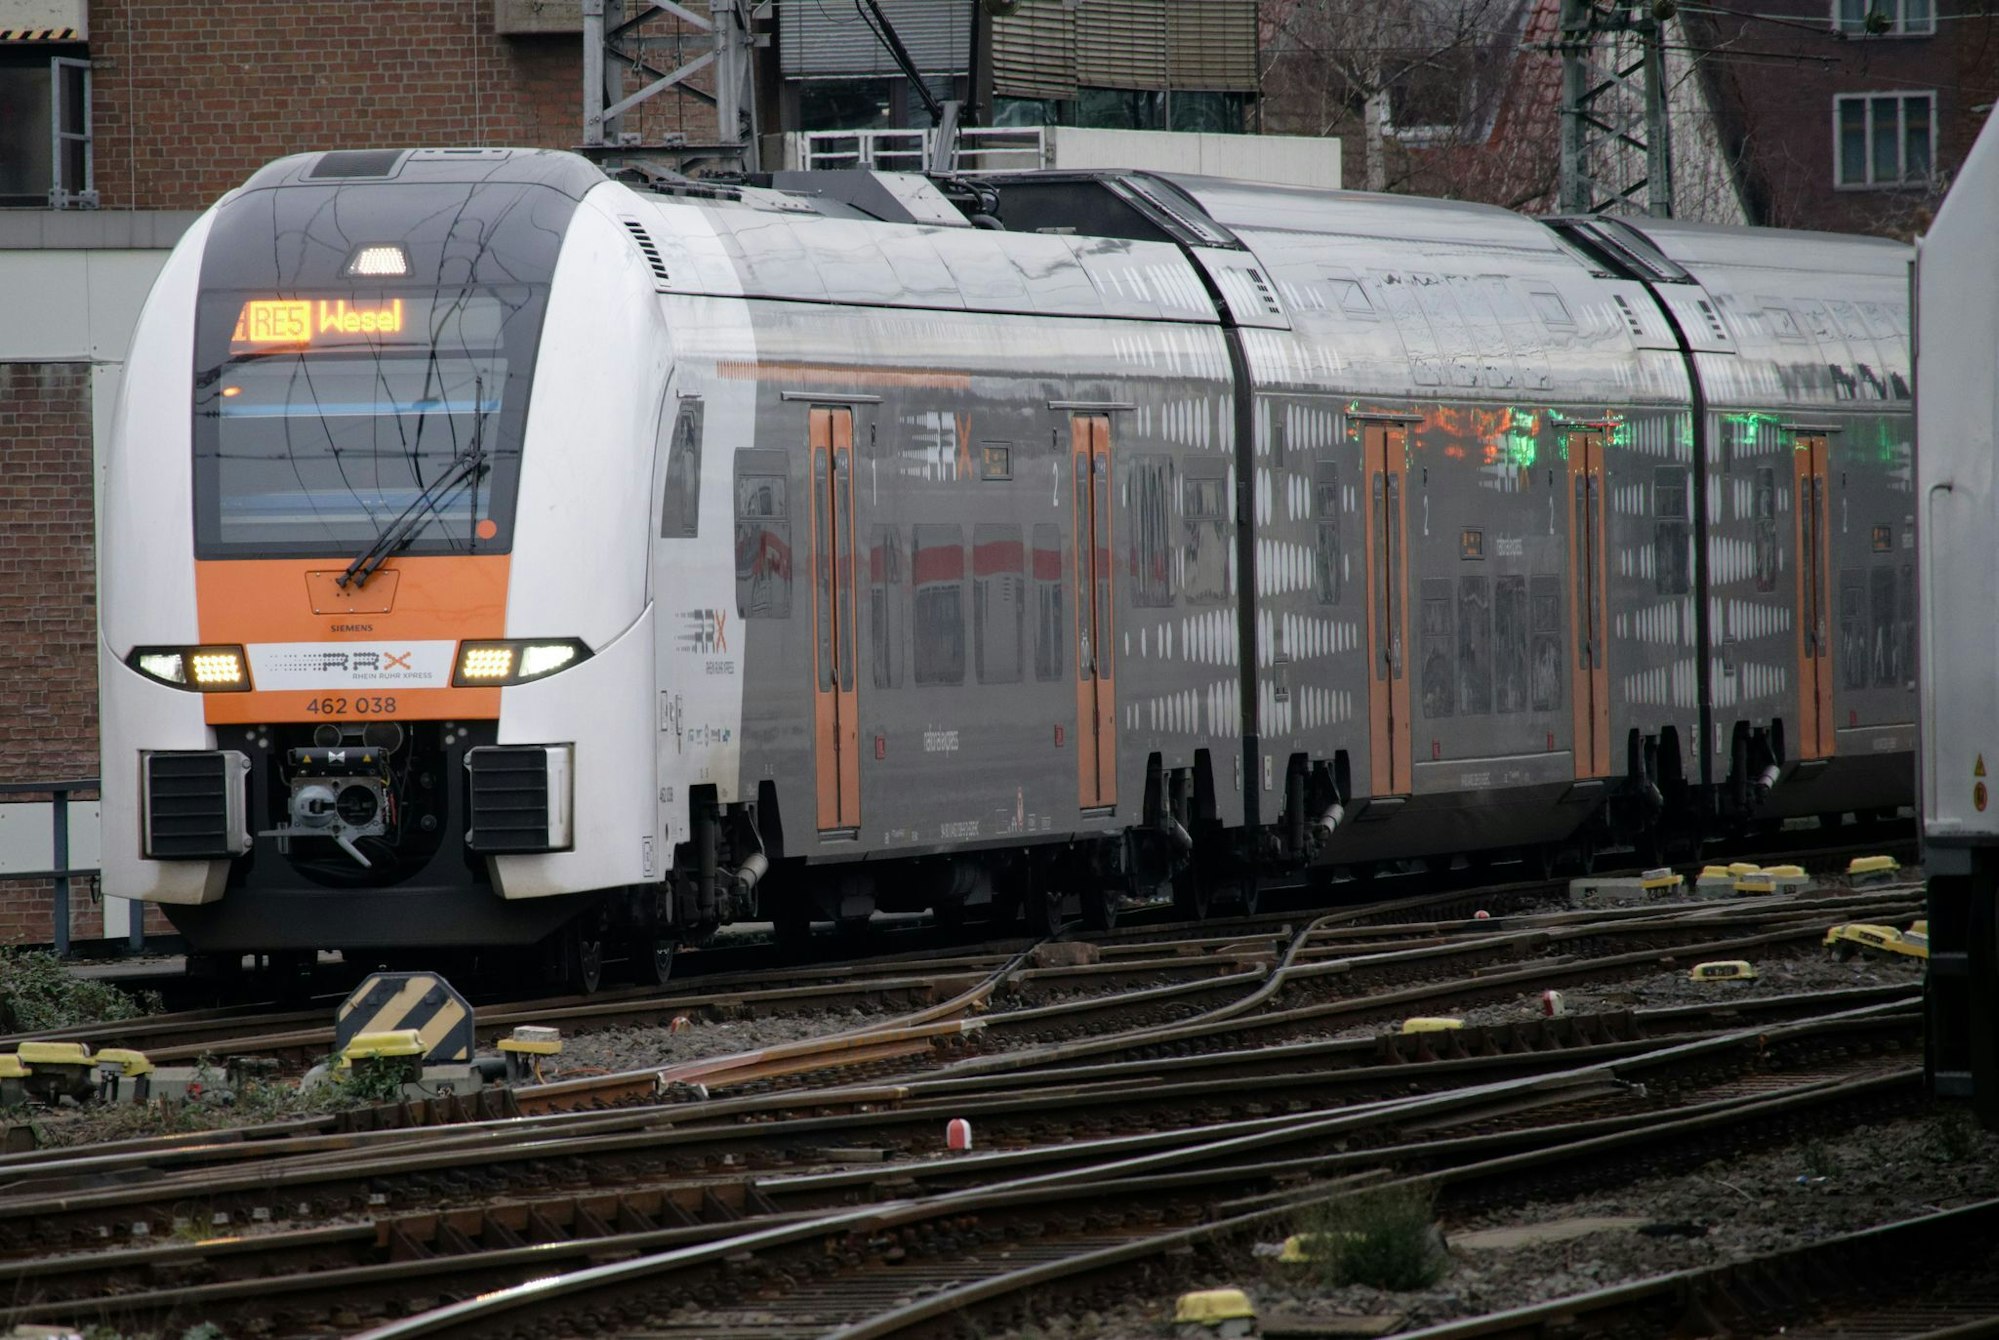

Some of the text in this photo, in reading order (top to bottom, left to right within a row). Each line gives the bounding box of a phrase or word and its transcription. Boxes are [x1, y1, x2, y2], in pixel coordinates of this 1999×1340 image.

[254, 305, 304, 337] RE5
[319, 298, 402, 333] Wesel
[330, 624, 373, 632] SIEMENS
[306, 697, 396, 714] 462 038
